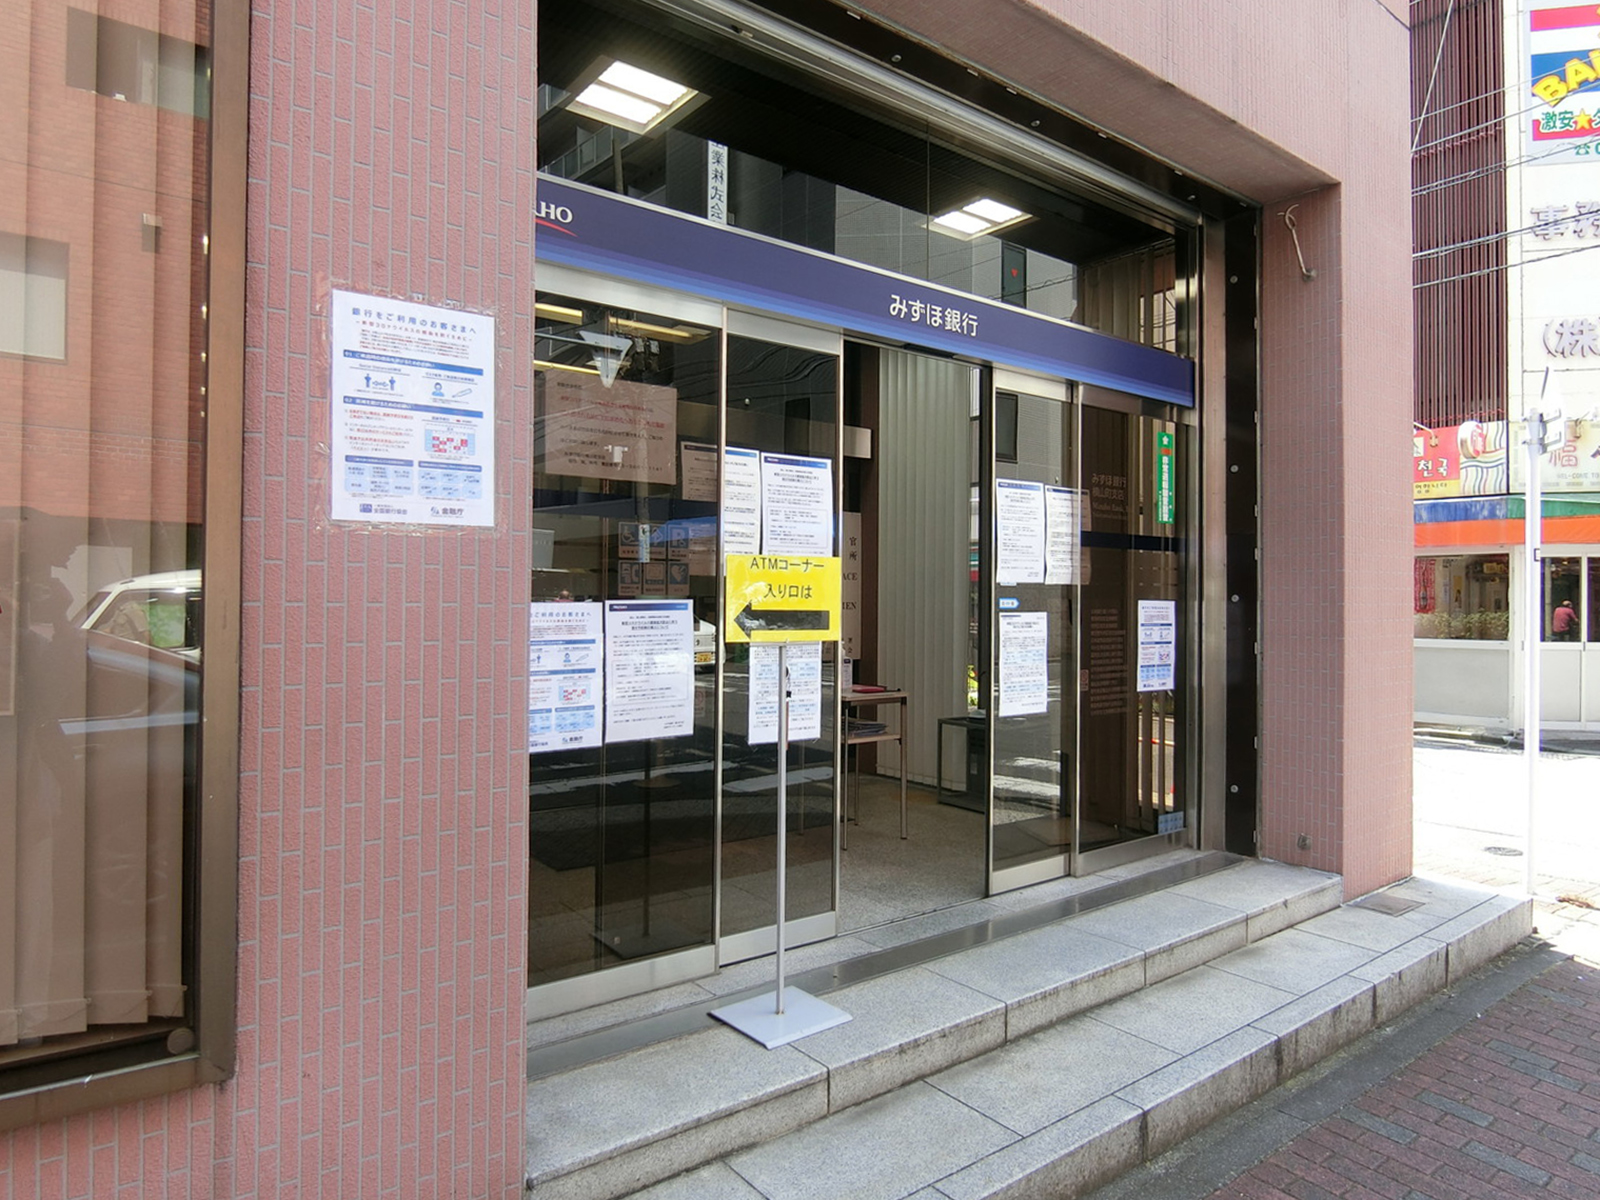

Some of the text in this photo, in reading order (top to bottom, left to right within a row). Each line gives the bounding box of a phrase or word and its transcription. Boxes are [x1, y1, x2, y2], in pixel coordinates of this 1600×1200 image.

[889, 294, 978, 337] みずほ銀行
[1417, 457, 1448, 478] 천국
[750, 556, 825, 573] ATMコーナー
[763, 583, 813, 599] 入り口は
